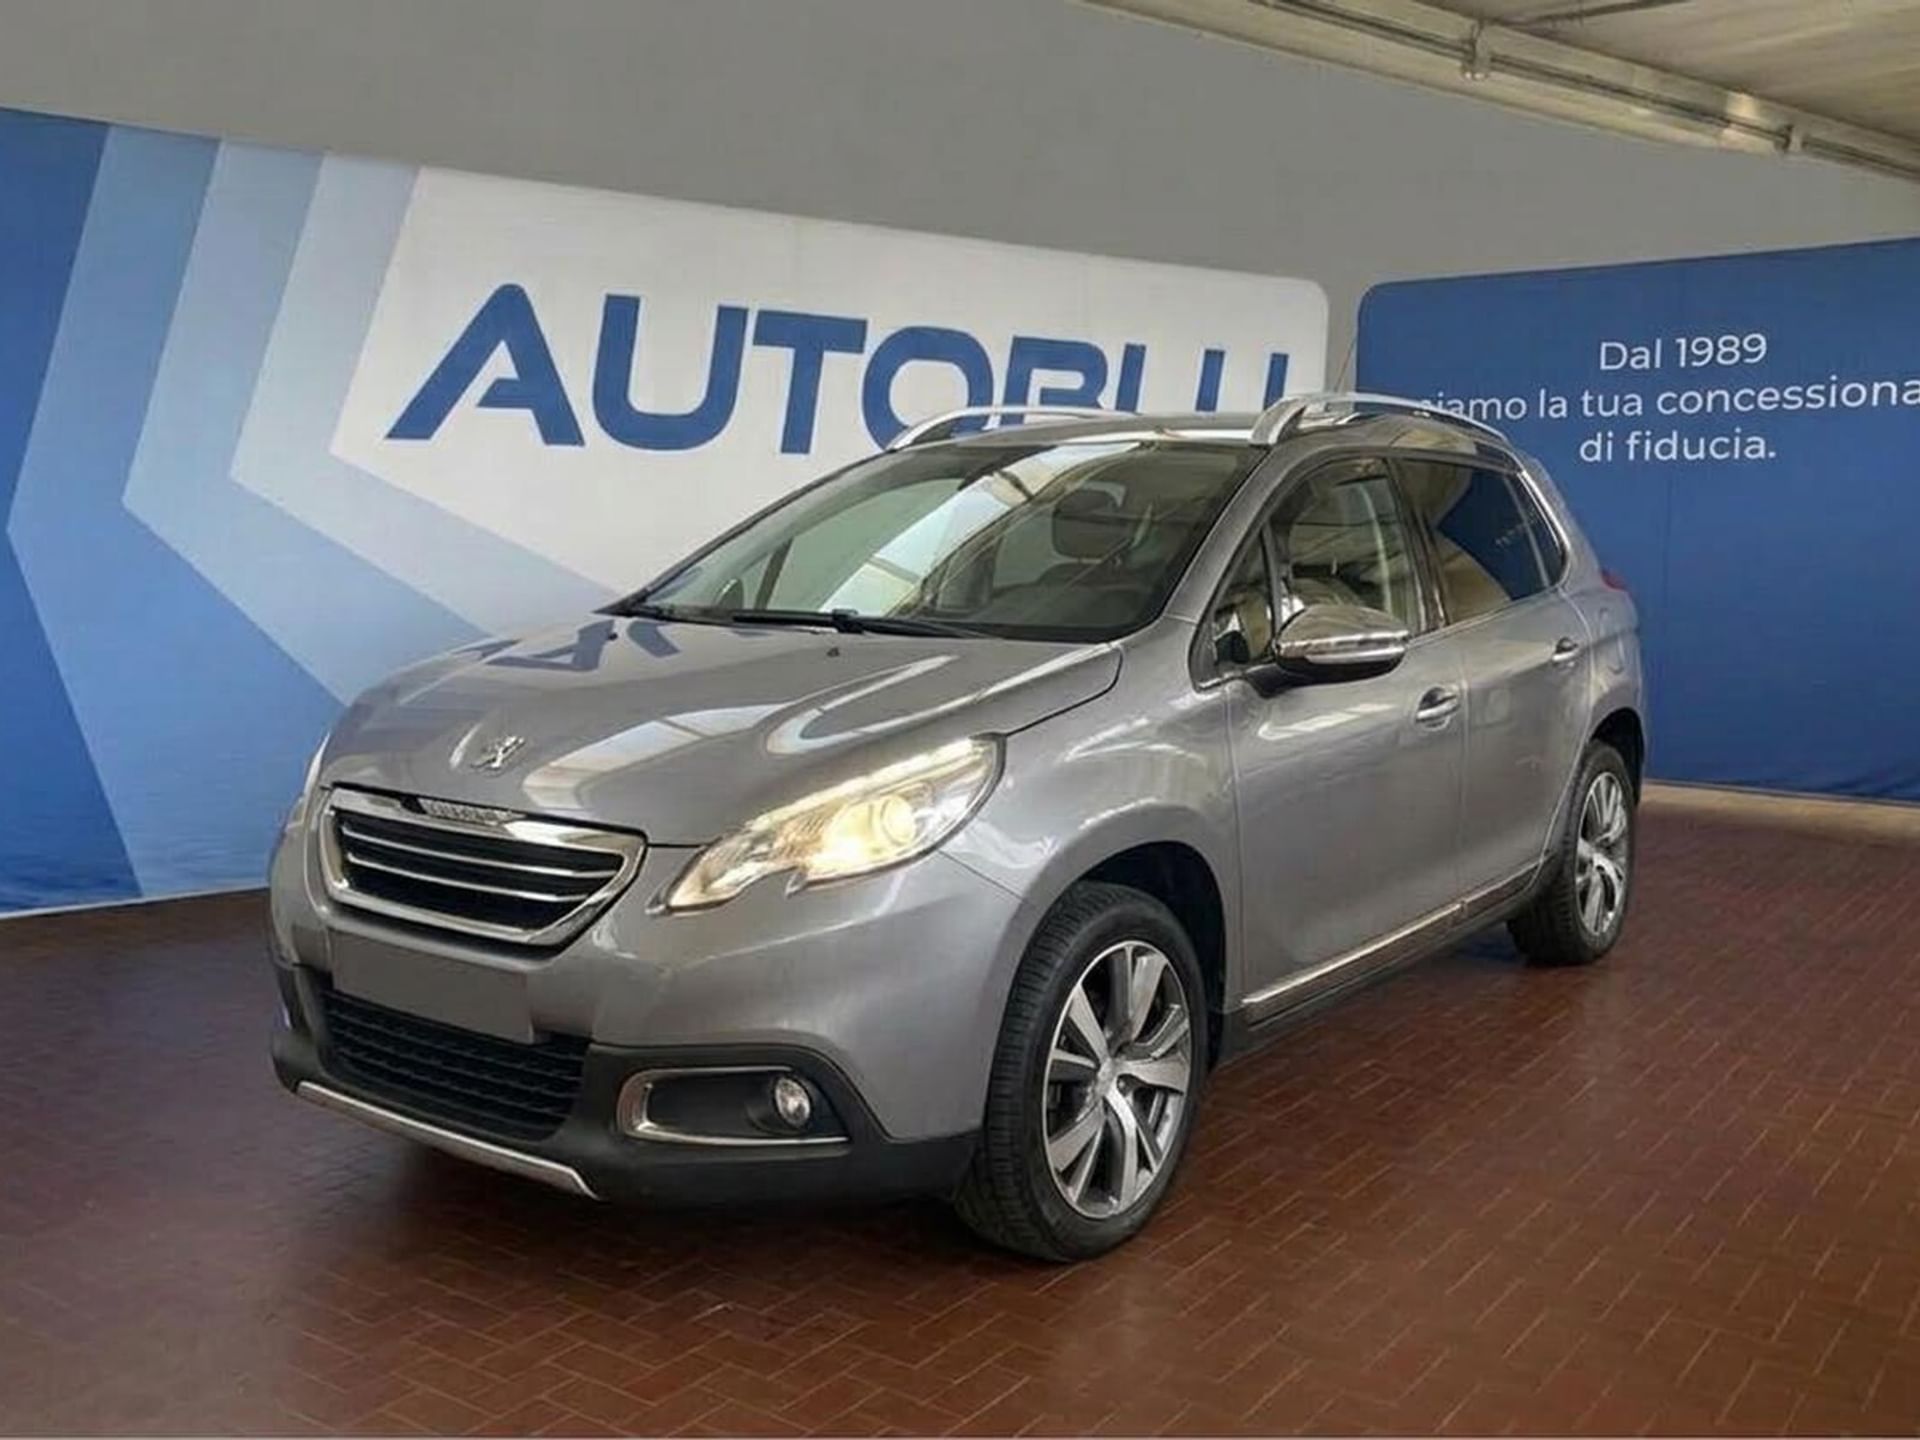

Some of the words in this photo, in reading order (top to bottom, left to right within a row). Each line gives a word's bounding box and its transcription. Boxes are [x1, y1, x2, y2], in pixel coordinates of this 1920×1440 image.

[1599, 338, 1661, 370] Dal
[1675, 333, 1767, 368] 1989
[1539, 388, 1568, 418] la
[1582, 390, 1643, 417] tua
[1656, 375, 1920, 415] concessiona
[1579, 431, 1614, 462] di
[1626, 428, 1776, 461] fiducia.
